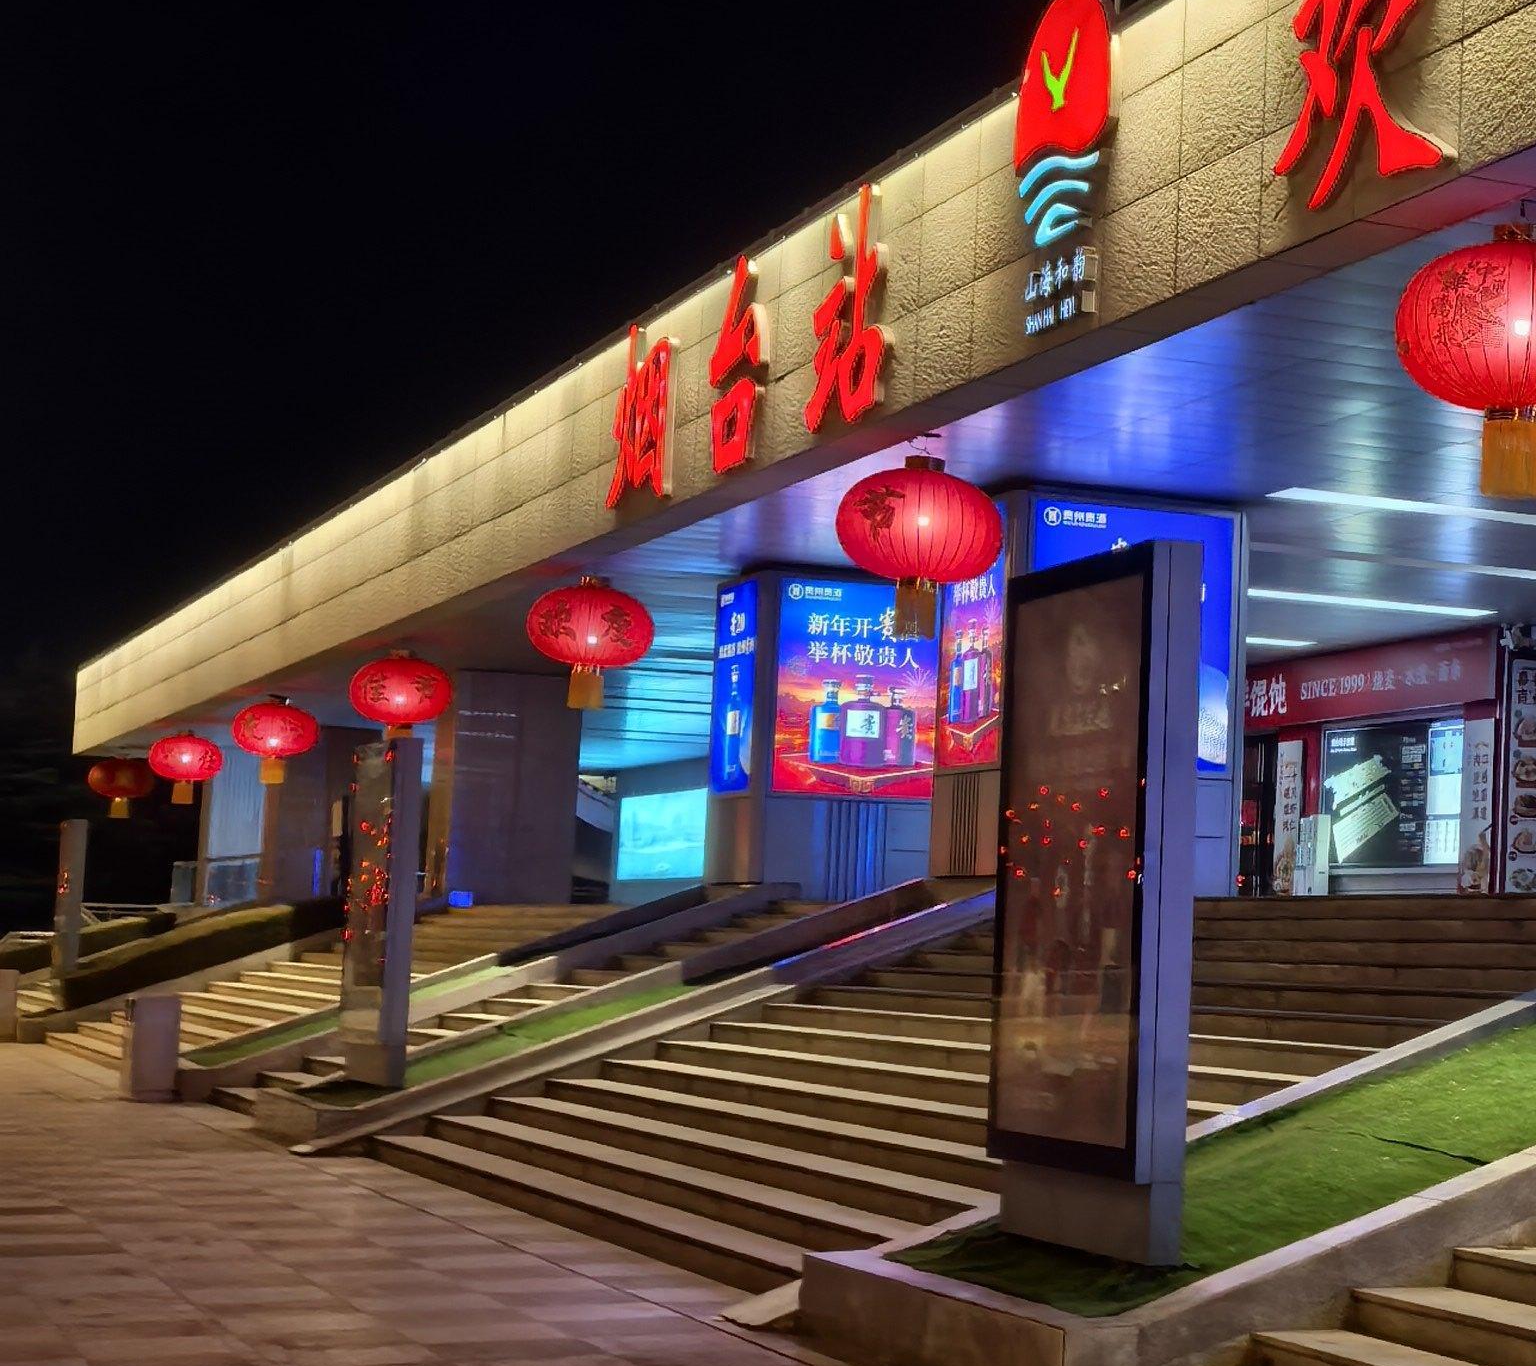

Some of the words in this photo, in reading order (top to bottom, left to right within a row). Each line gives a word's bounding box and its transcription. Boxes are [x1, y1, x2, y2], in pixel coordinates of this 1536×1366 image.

[606, 183, 890, 510] 烟台站
[807, 606, 920, 643] 新年开贵
[807, 640, 920, 669] 举杯敬贵人
[1245, 673, 1288, 718] 馄饨
[1301, 678, 1336, 701] SINCE
[1340, 673, 1365, 696] 1999
